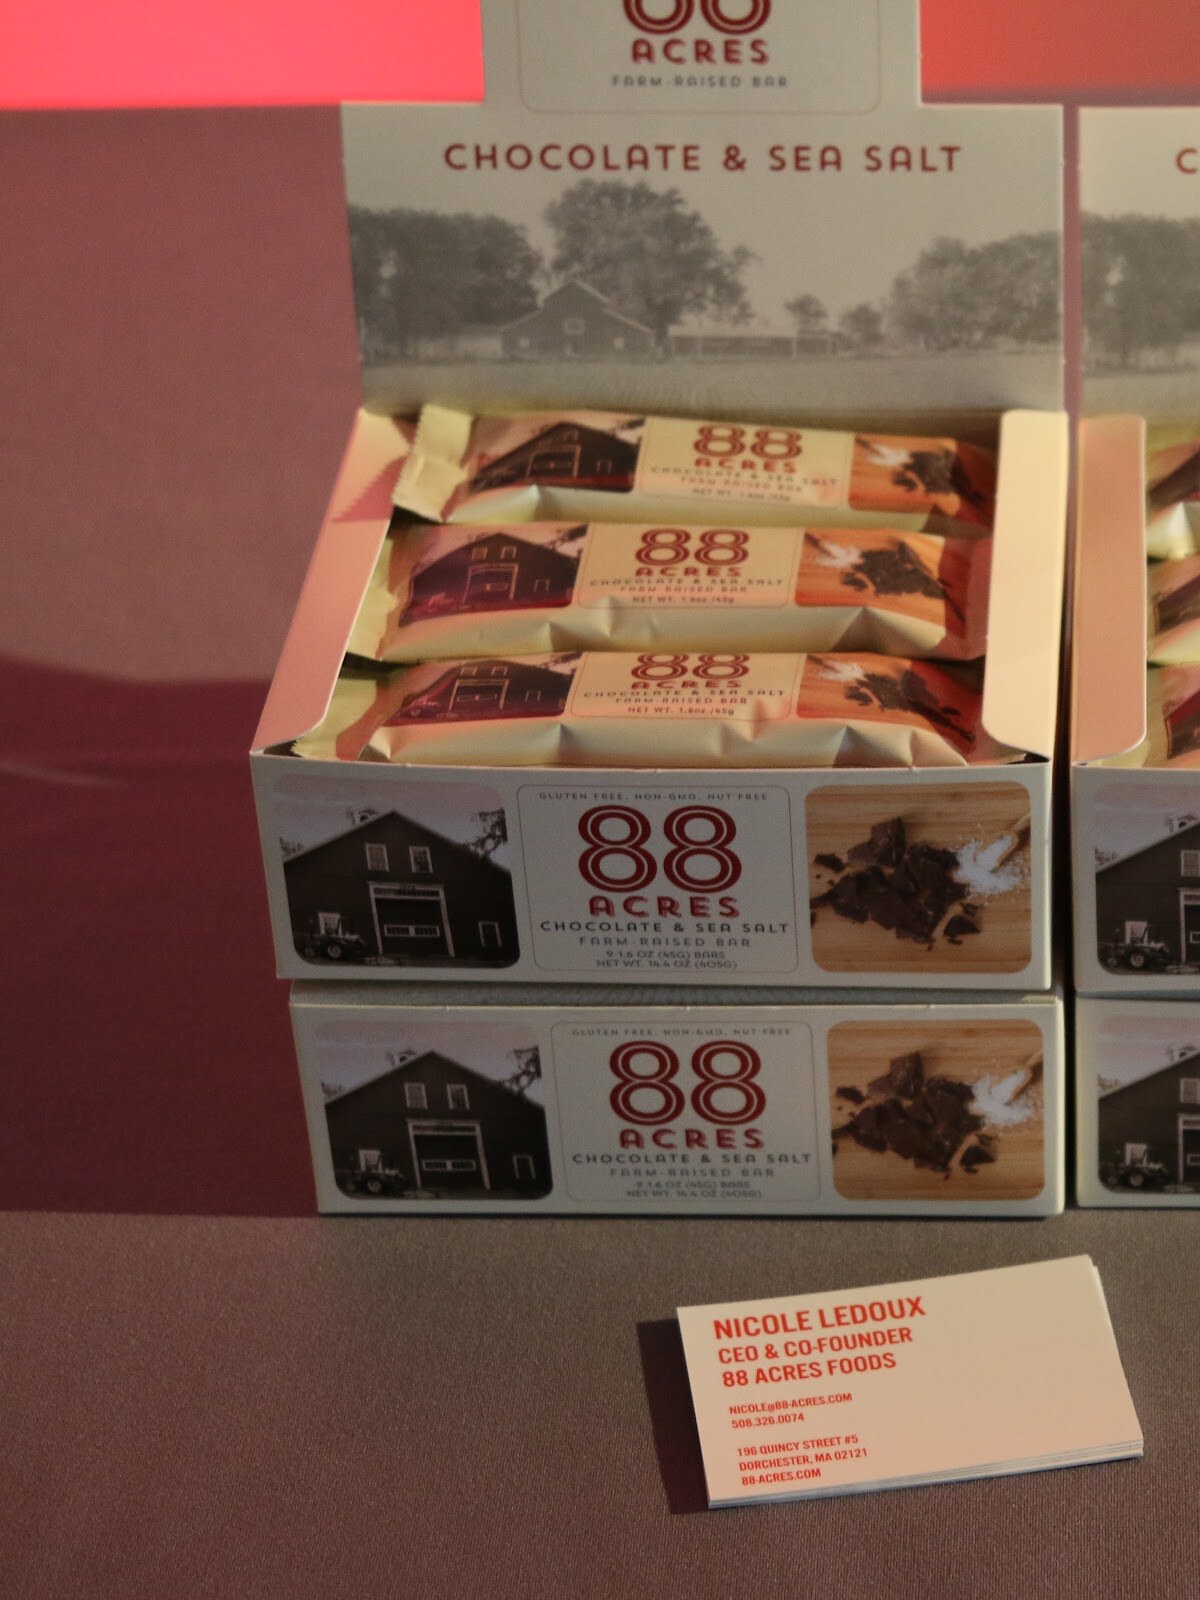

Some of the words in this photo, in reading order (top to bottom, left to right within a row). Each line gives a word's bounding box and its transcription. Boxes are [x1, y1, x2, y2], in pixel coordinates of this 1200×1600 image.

[632, 38, 770, 64] ACRES
[752, 74, 790, 89] BAR
[444, 143, 700, 172] CHOCOLATE
[723, 145, 748, 172] &
[768, 145, 843, 173] SEA
[865, 145, 962, 173] SALT
[693, 424, 803, 460] 88
[694, 457, 797, 474] ACRES
[635, 528, 750, 566] 88
[636, 566, 741, 577] ACRES
[630, 653, 750, 681] 88
[584, 689, 682, 698] CHOCOLATE
[710, 689, 738, 697] SEA
[748, 689, 785, 697] SALT
[632, 680, 741, 690] ACRES
[628, 706, 649, 714] NET
[539, 792, 587, 800] GLUTEN
[708, 793, 732, 801] NUT
[738, 793, 768, 801] FREE
[578, 804, 742, 894] 88
[588, 895, 740, 918] ACRES
[540, 921, 663, 933] CHOCOLATE
[674, 922, 685, 933] &
[696, 922, 732, 934] SEA
[742, 922, 789, 934] SALT
[716, 937, 750, 948] BAR
[596, 960, 620, 968] NET
[674, 960, 690, 968] OZ
[637, 951, 654, 960] OZ
[658, 951, 690, 960] (45G)
[694, 951, 725, 960] BARS
[610, 1040, 766, 1126] 88
[619, 1129, 764, 1150] ACRES
[572, 1154, 690, 1164] CHOCOLATE
[700, 1154, 712, 1164] &
[722, 1154, 756, 1164] SEA
[767, 1154, 812, 1164] SALT
[742, 1168, 775, 1178] BAR
[714, 1310, 813, 1340] NICOLE
[818, 1296, 926, 1329] LEDOUX
[718, 1344, 759, 1364] CEO
[765, 1344, 779, 1360] &
[784, 1327, 912, 1357] CO-FOUNDER
[722, 1370, 748, 1388] 88
[755, 1362, 822, 1384] ACRES
[827, 1352, 897, 1376] FOODS
[729, 1392, 852, 1416] NICOLE@88-ACRES.COM
[732, 1412, 805, 1429] 508.326.0074
[738, 1447, 758, 1457] 196
[760, 1442, 800, 1455] QUINCY
[803, 1436, 842, 1450] STREET
[845, 1434, 858, 1444] #5
[738, 1456, 812, 1472] DORCHESTER,
[816, 1452, 833, 1463] MA
[834, 1448, 868, 1460] 02121
[742, 1468, 822, 1486] 88-ACRES.COM
